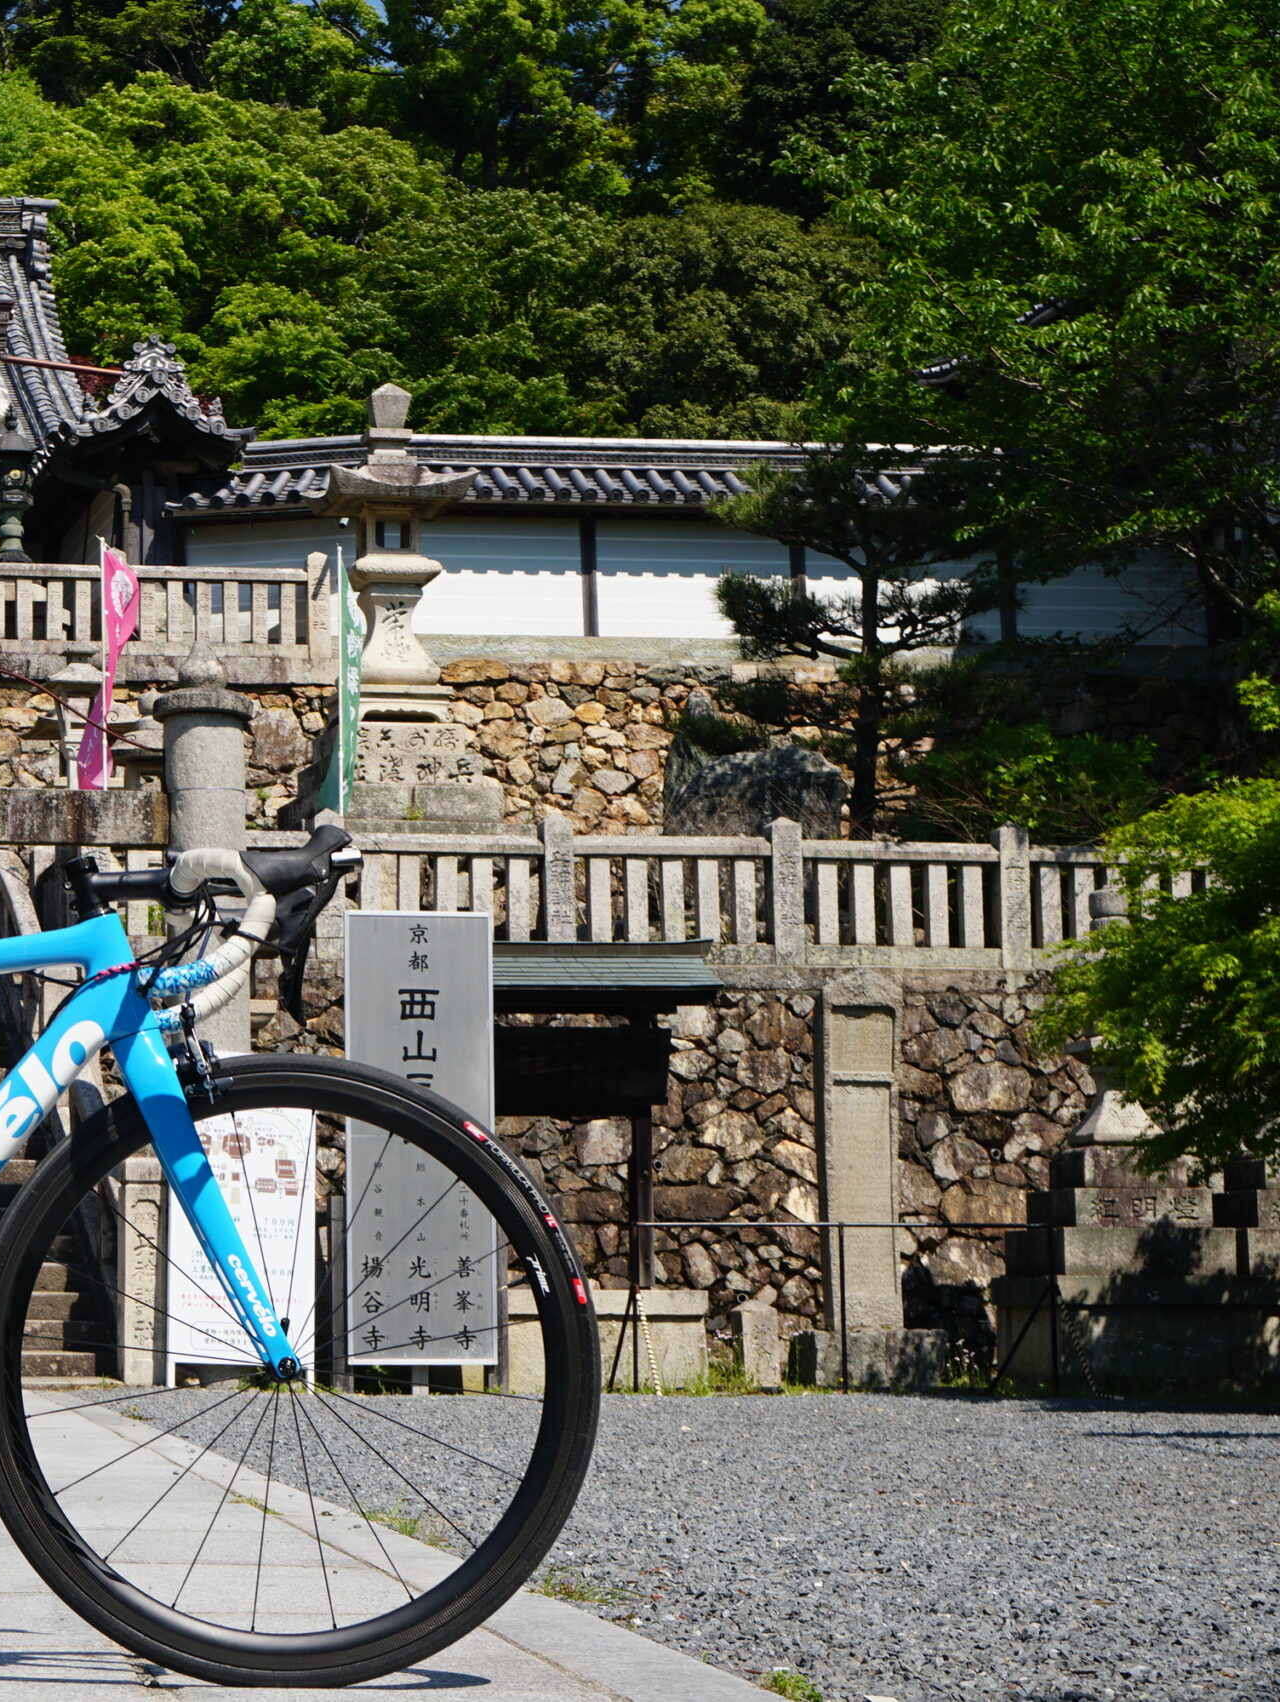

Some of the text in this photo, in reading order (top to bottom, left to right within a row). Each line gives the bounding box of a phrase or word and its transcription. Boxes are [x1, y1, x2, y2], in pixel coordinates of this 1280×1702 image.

[407, 924, 429, 973] 京都
[485, 1139, 532, 1190] FORMULA
[528, 1188, 549, 1214] PRO
[227, 1254, 277, 1337] cervélo
[407, 1255, 433, 1351] 光明寺
[453, 1255, 477, 1350] 善峯寺
